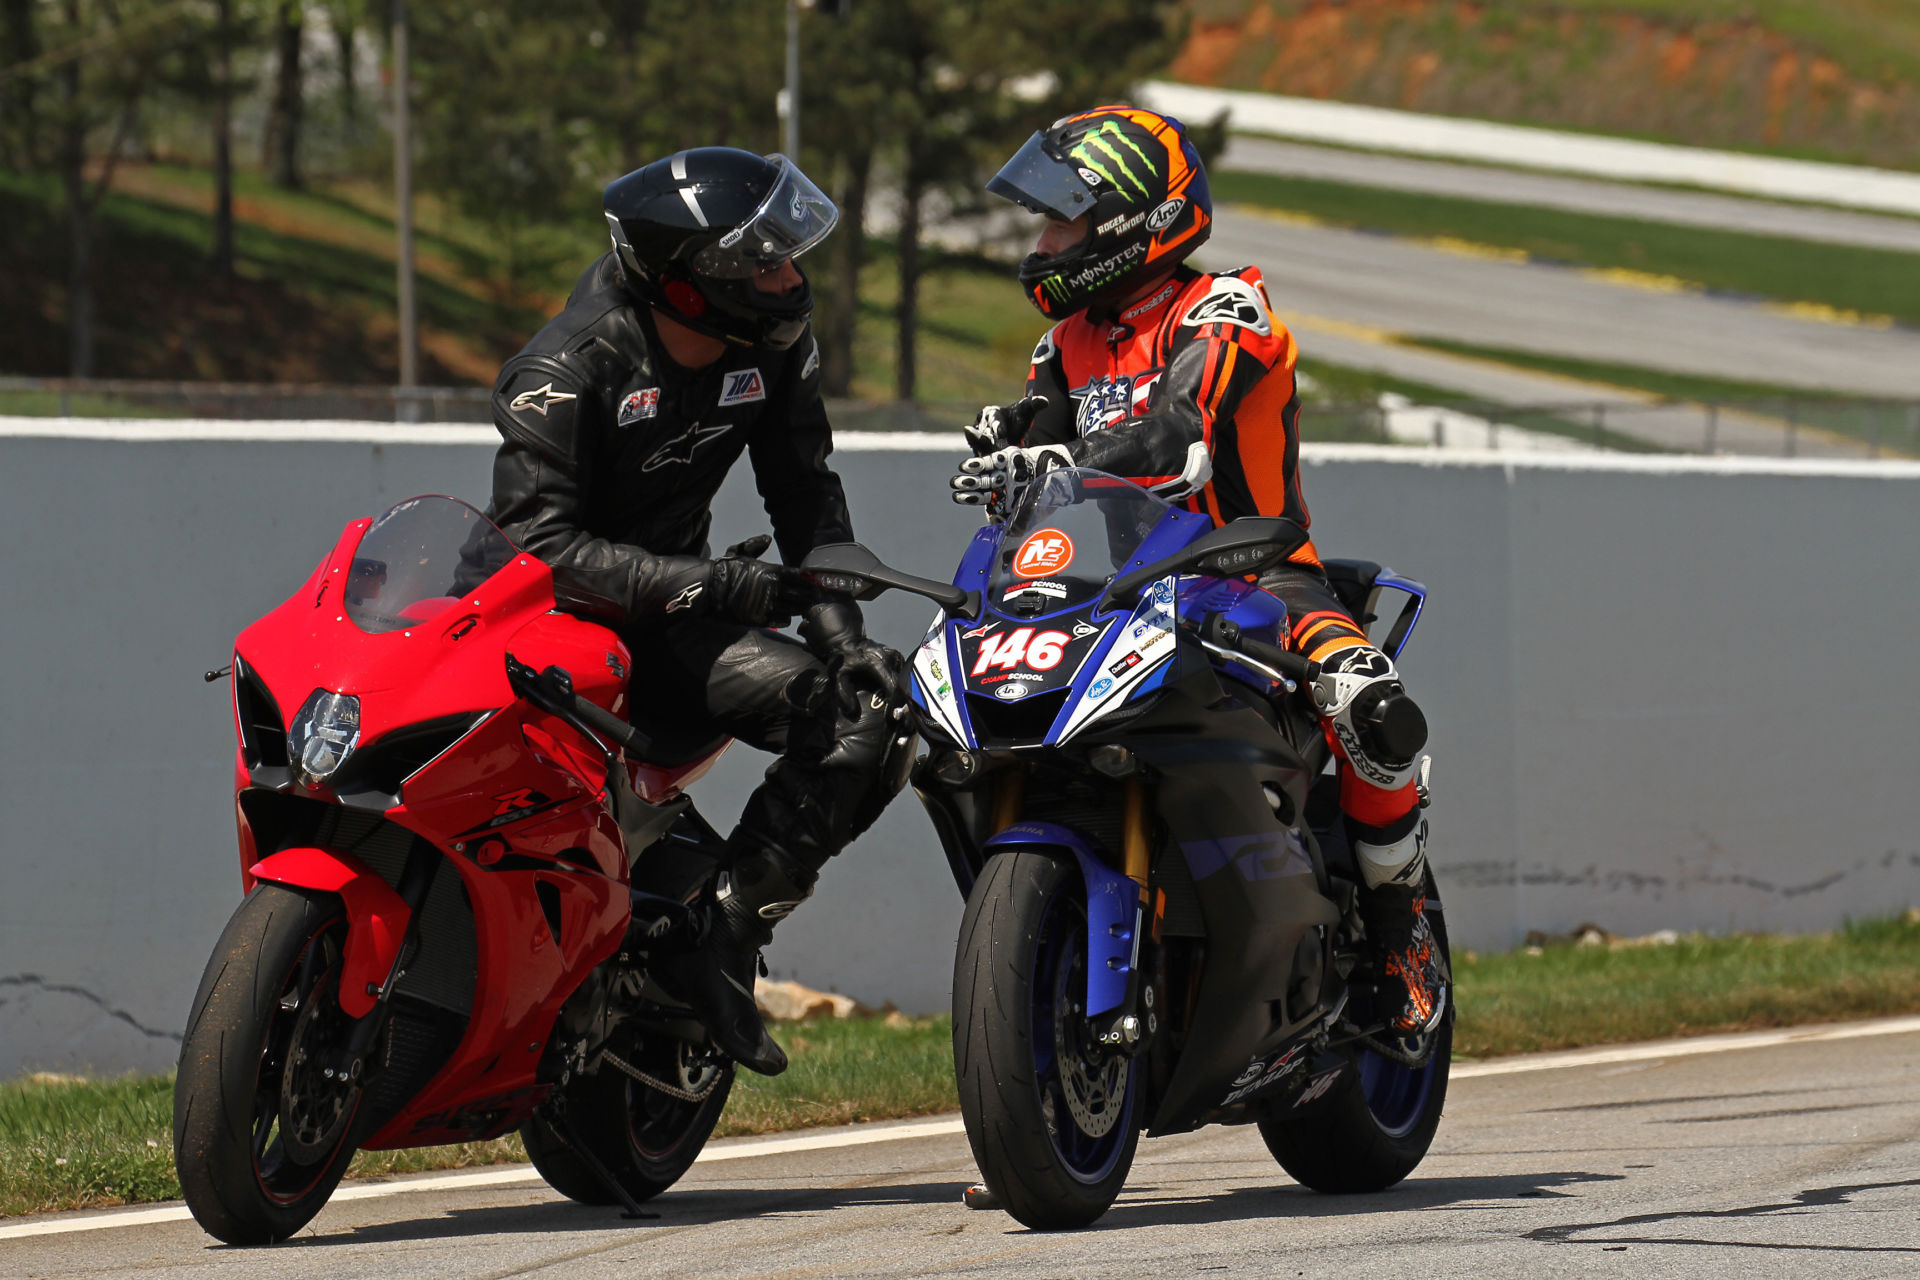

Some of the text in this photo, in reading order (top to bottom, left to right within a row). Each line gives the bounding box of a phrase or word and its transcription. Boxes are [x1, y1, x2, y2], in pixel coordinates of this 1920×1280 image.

[1096, 213, 1126, 236] ROGER
[1114, 211, 1146, 237] HAYDEN
[1152, 201, 1181, 228] Arai
[722, 231, 741, 246] SHOEI
[1069, 241, 1146, 288] MONSTER
[629, 389, 660, 410] CCS
[1020, 539, 1065, 566] N2
[970, 627, 1072, 677] 146
[980, 673, 1044, 685] CHAMPSCHOOL
[1220, 1057, 1304, 1106] DUNLOP
